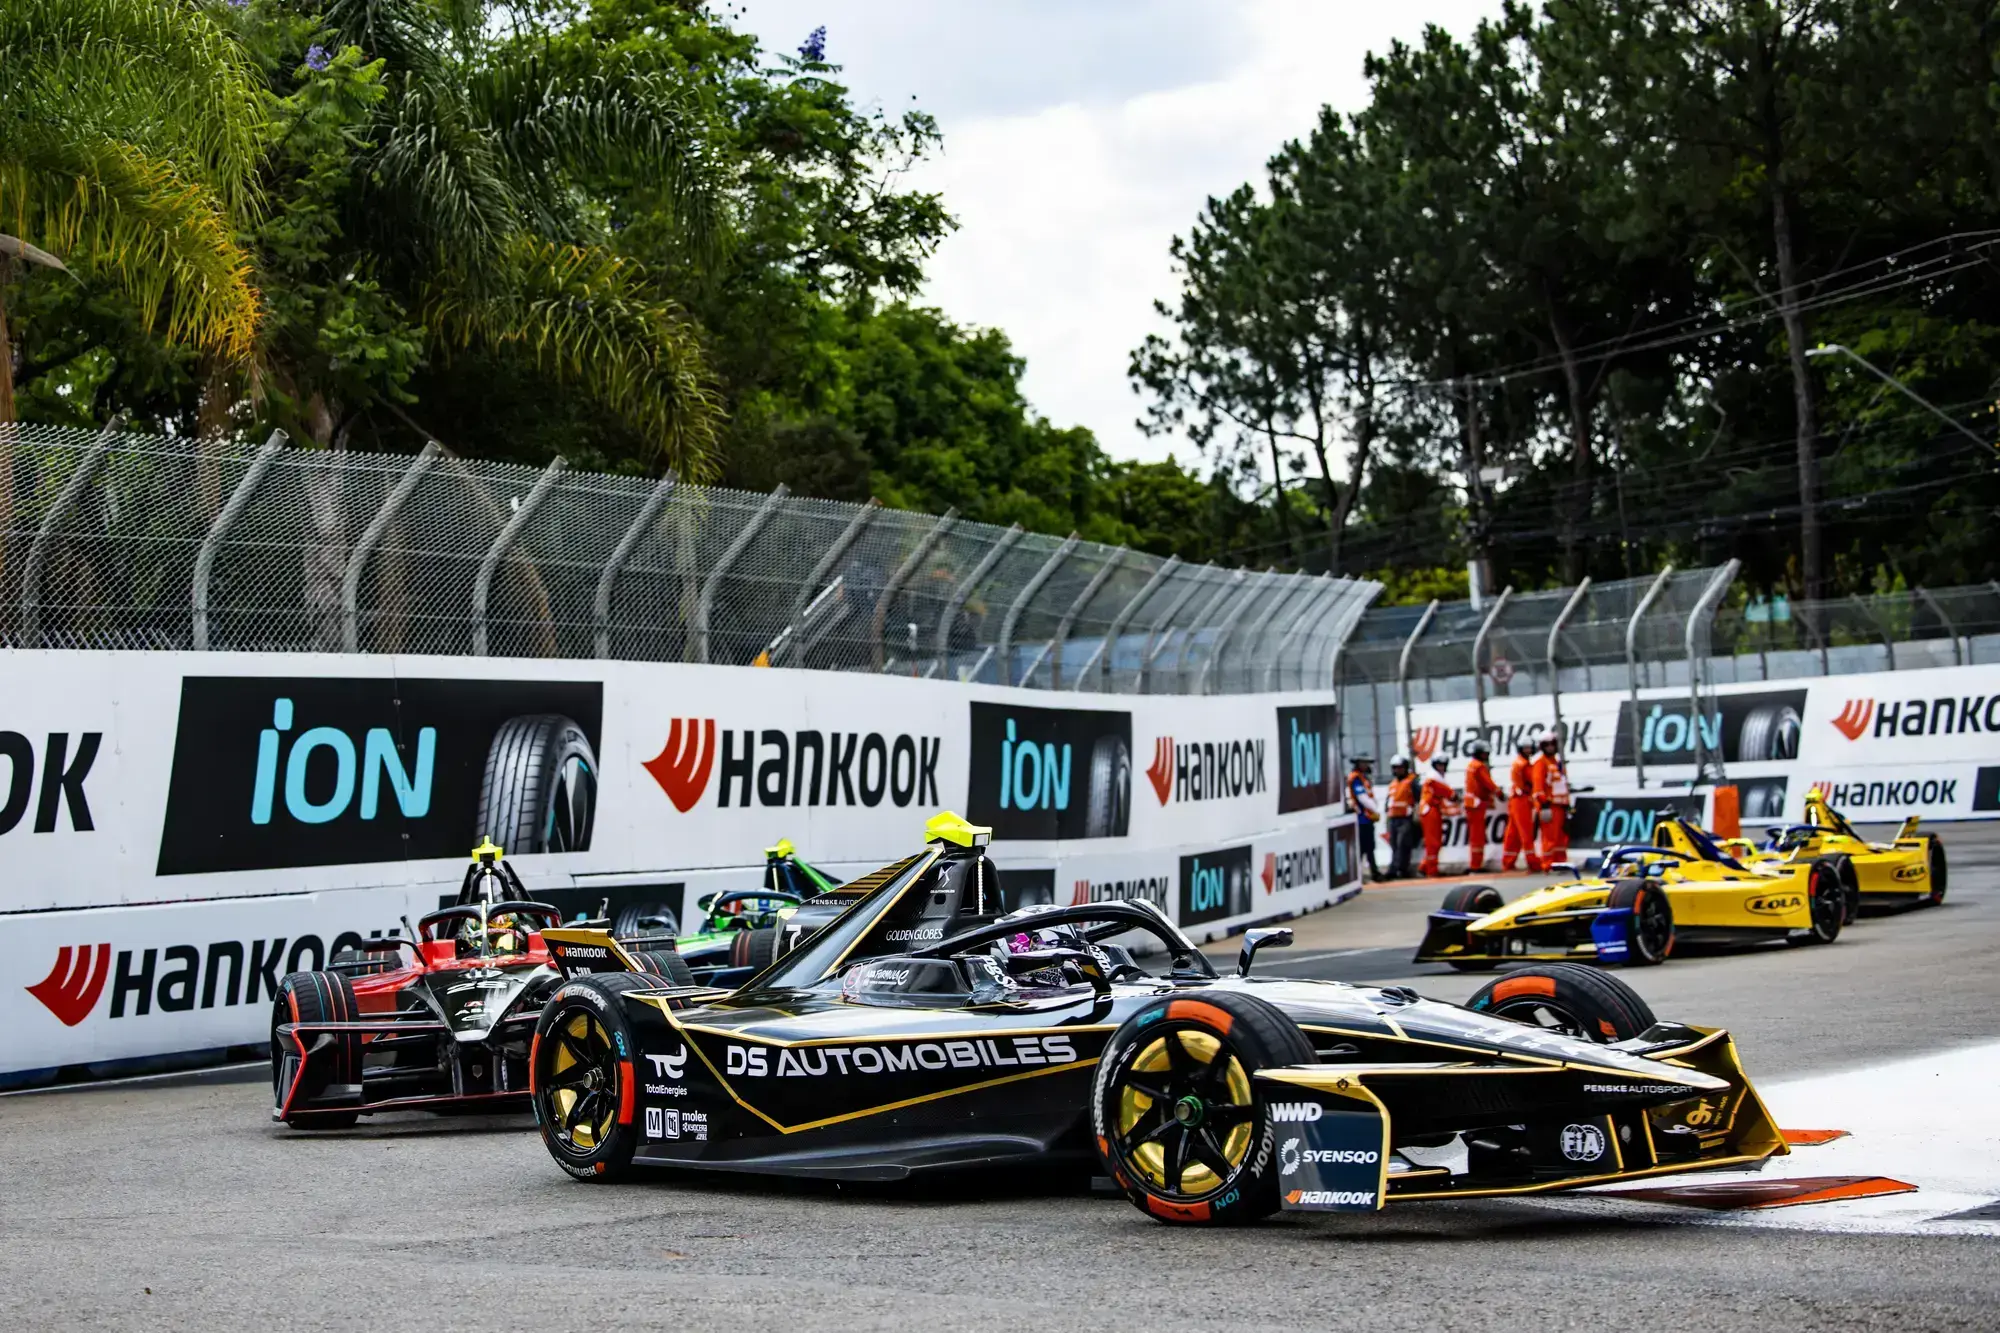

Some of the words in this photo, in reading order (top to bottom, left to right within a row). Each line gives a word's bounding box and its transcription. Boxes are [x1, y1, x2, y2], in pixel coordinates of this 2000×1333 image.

[251, 698, 436, 825] iON
[1001, 718, 1071, 811] iON
[1752, 897, 1801, 910] LOLA
[886, 930, 913, 941] GOLDEN
[914, 928, 943, 939] GLOBES
[727, 1045, 768, 1076] DS
[776, 1035, 1077, 1077] AUTOMOBILES
[645, 1083, 688, 1098] TotalEnergies
[1583, 1084, 1627, 1093] PENSKE
[1628, 1085, 1693, 1094] AUTOSPORT
[682, 1110, 707, 1122] molex
[1271, 1102, 1323, 1122] WWD
[1302, 1150, 1378, 1164] SYENSQO
[1299, 1191, 1376, 1205] HanKOOK
